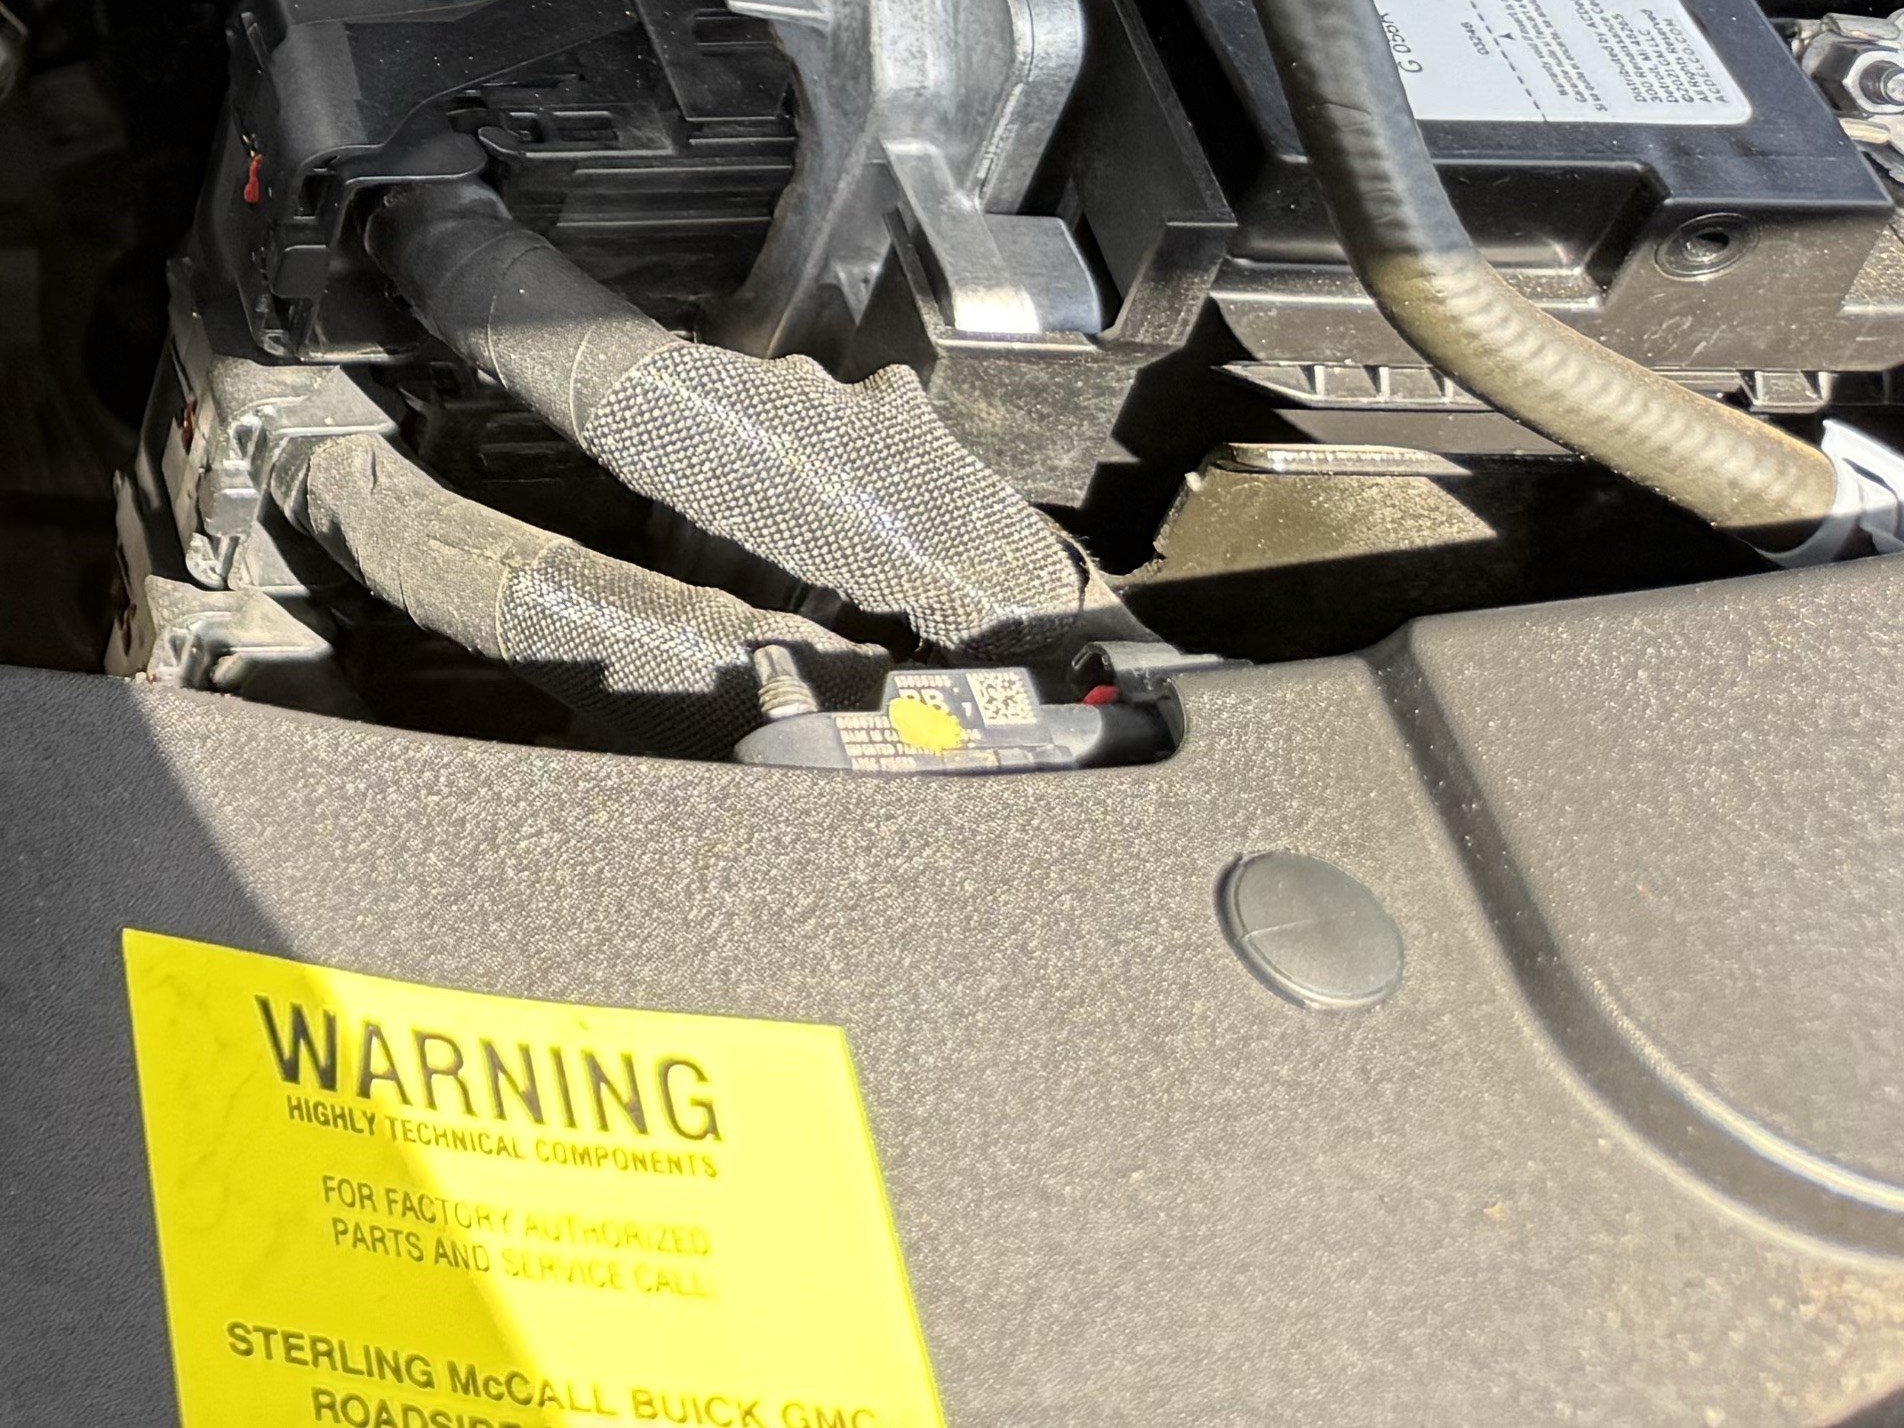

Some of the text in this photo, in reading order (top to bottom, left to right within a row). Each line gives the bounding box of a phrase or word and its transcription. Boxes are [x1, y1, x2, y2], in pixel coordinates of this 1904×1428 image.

[1593, 31, 1610, 43] by
[1600, 16, 1647, 78] Renaissance
[1610, 13, 1641, 47] 48265
[1637, 49, 1652, 62] MI
[1638, 28, 1660, 48] LLC
[1640, 8, 1711, 103] All Rights Reserved
[1652, 50, 1671, 67] GM
[1662, 18, 1728, 103] ACDELCO.COM
[1601, 46, 1648, 102] Distributed
[1641, 81, 1664, 102] 300
[254, 993, 724, 1142] WARNING
[287, 1095, 719, 1178] HIGHLY TECHNICAL COMPONENTS
[322, 1175, 710, 1256] FOR FACTORY AUTHORIZED
[331, 1217, 424, 1262] PARTS
[433, 1237, 491, 1273] AND
[500, 1249, 622, 1291] SERVICE
[225, 1319, 878, 1428] STERLING McCALL BUICK GMC
